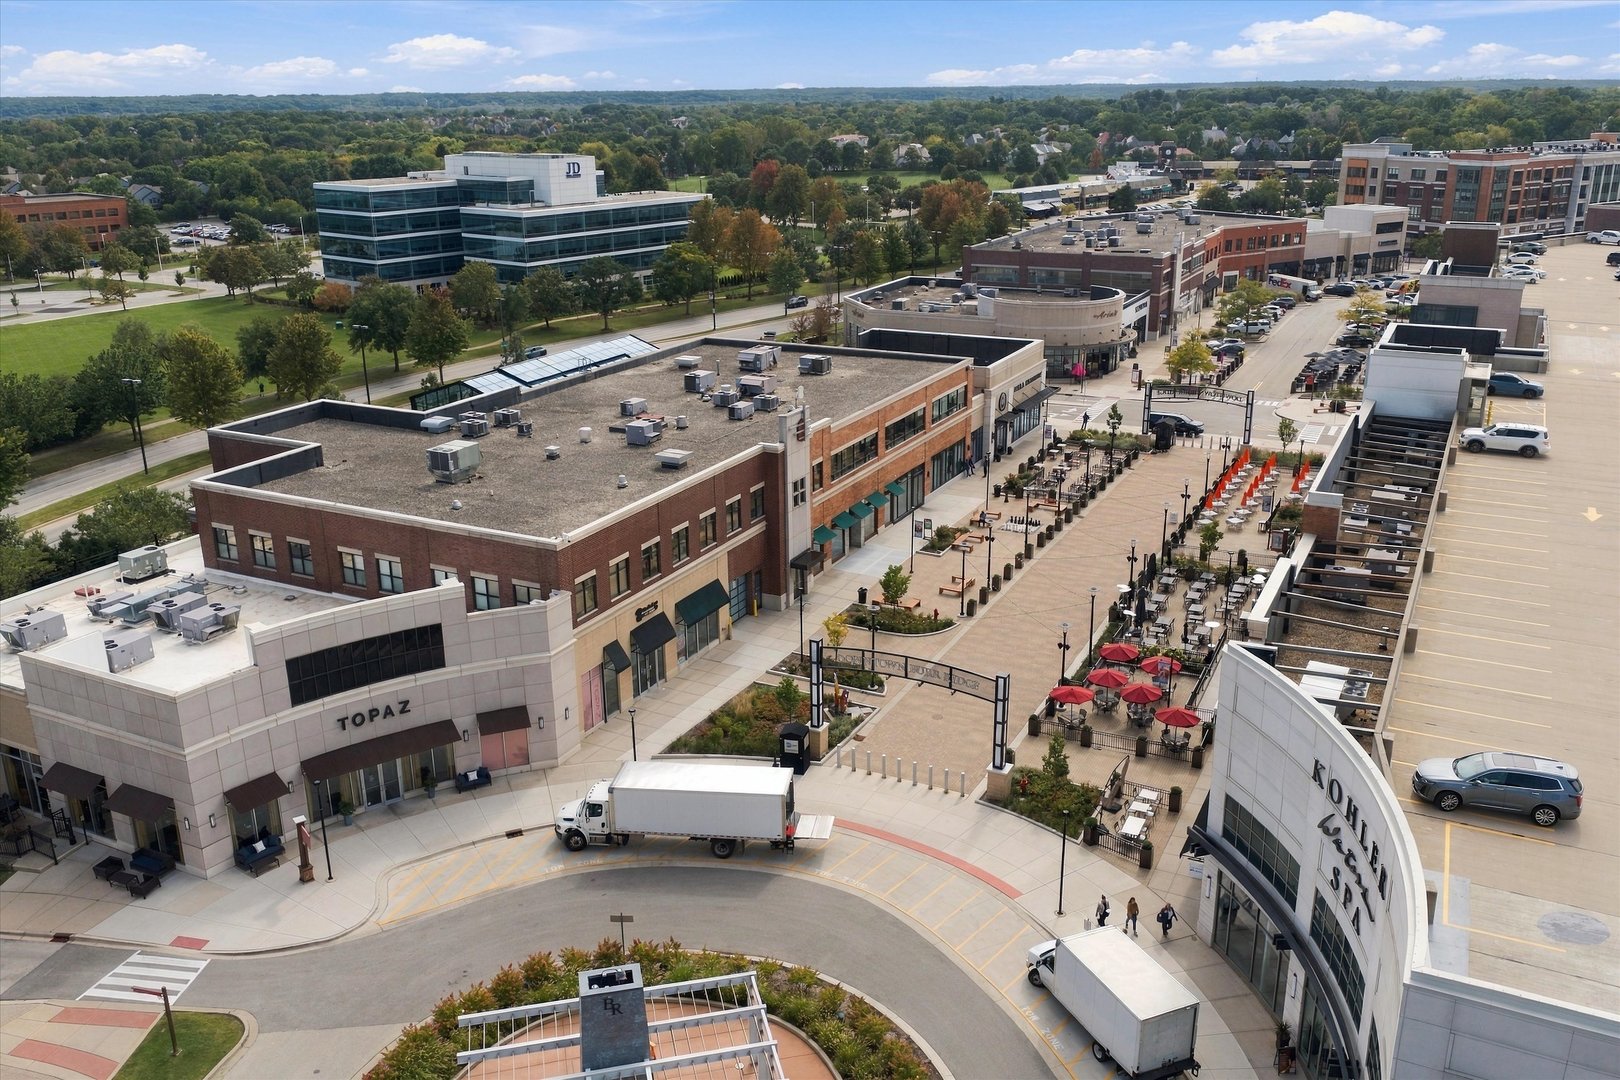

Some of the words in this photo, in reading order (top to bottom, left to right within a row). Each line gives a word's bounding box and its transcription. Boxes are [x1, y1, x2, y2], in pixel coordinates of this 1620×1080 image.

[566, 161, 581, 175] JD
[1268, 275, 1292, 289] FedEx
[336, 699, 411, 731] TOPAZ
[1311, 757, 1387, 901] KOHLER
[1331, 866, 1361, 936] SPA
